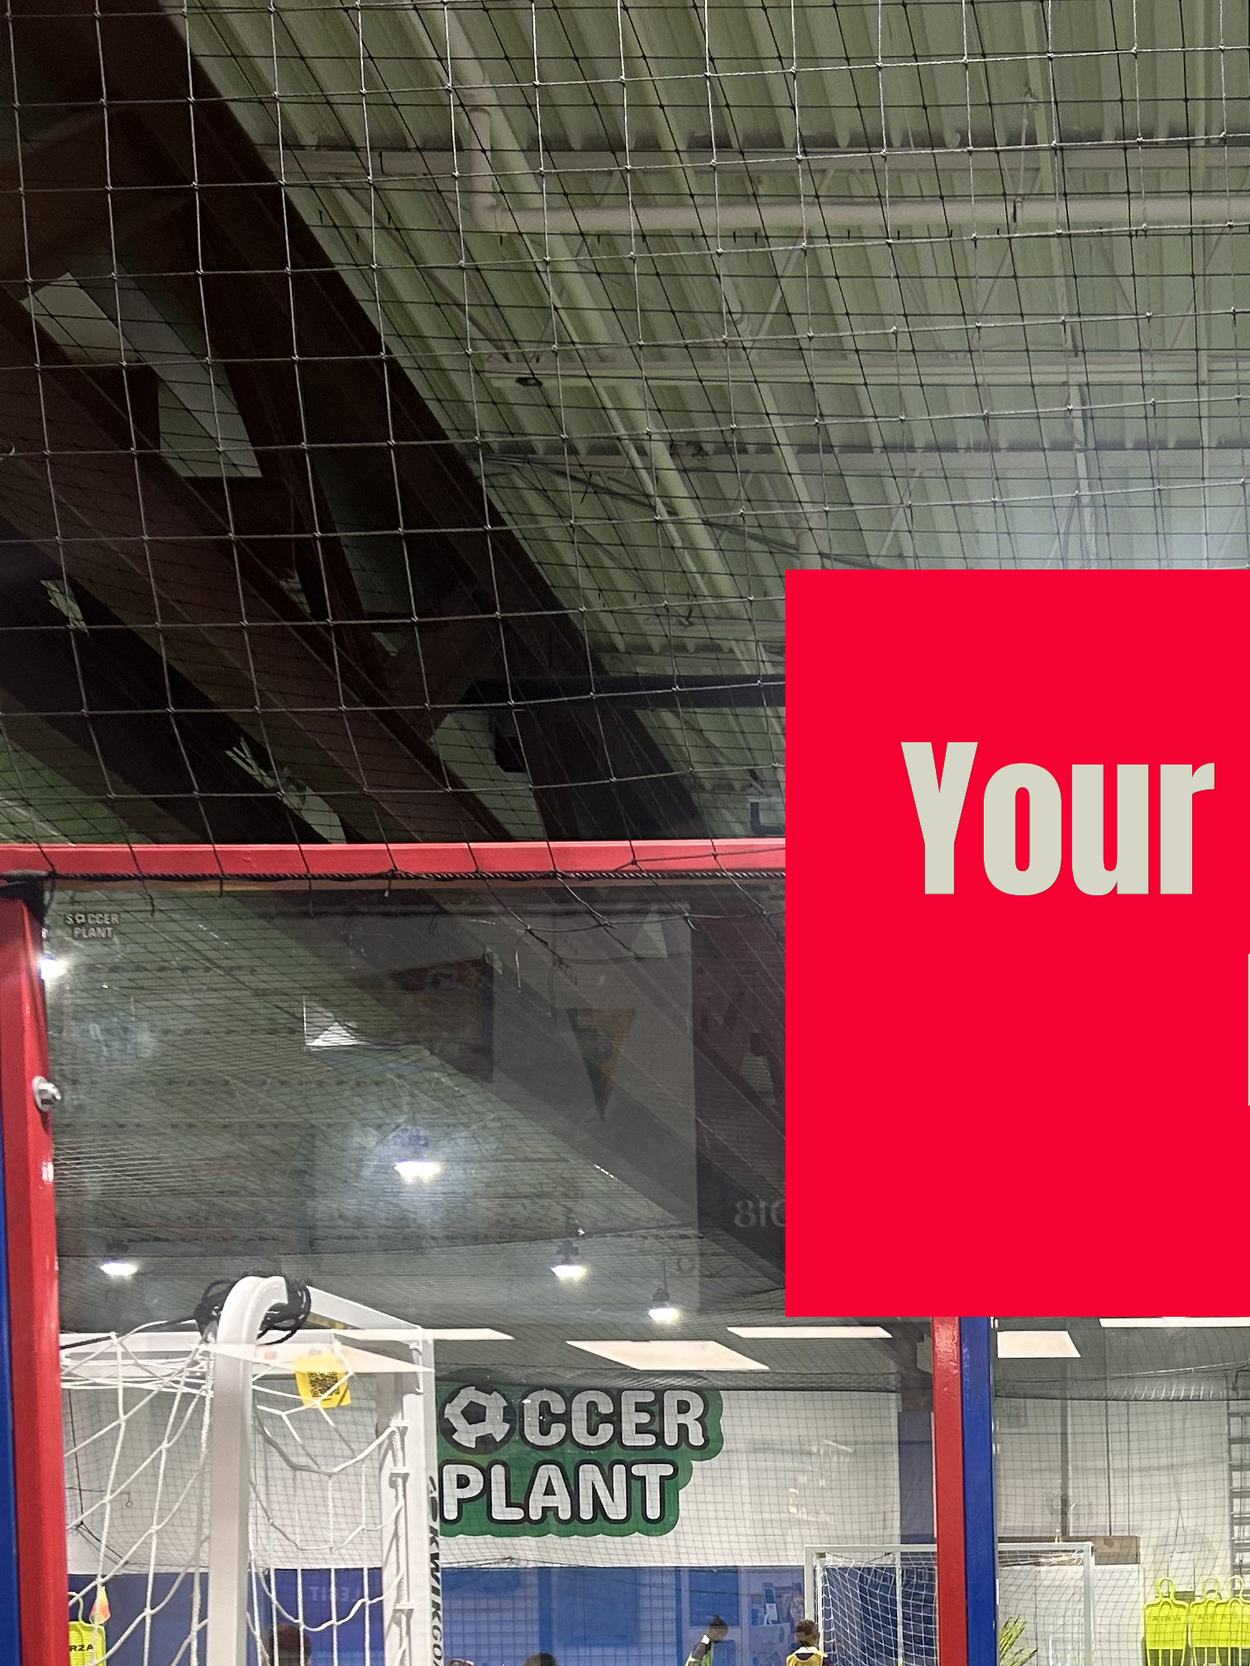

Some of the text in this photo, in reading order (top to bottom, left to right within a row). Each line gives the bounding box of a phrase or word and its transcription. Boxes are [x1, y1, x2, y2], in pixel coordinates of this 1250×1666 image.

[73, 926, 114, 939] PLANT
[442, 1462, 675, 1523] PLANT
[69, 1644, 94, 1652] RZA
